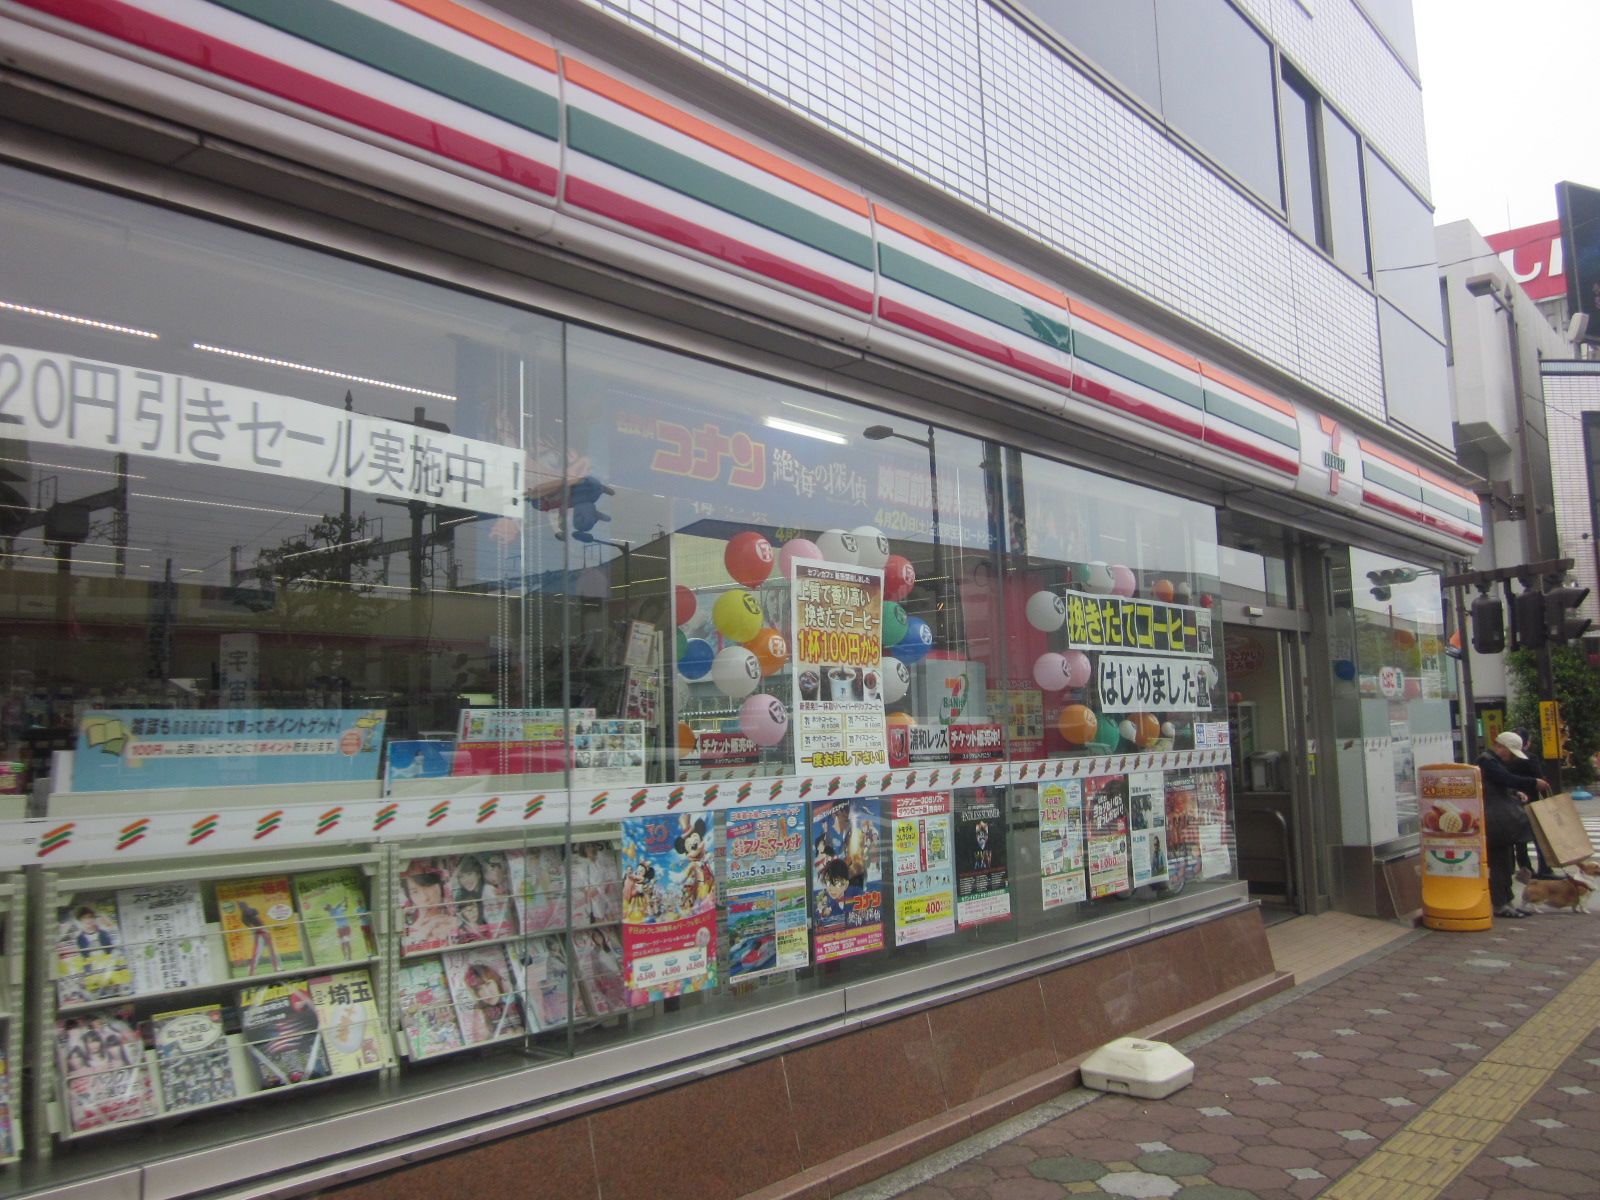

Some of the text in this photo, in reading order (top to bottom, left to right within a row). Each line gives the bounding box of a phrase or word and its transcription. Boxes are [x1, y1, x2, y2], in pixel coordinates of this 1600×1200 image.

[651, 419, 766, 491] コナン
[772, 447, 868, 508] 絶海の探偵
[798, 580, 870, 608] 上質で香り高い
[805, 602, 880, 631] 挽きたてコーヒー
[1069, 594, 1198, 650] 挽きたてコーヒー
[798, 627, 881, 667] 1杯100円から
[1101, 661, 1196, 706] はじめました
[910, 728, 1002, 751] 浦和レッズ チケット販売中!
[853, 891, 882, 911] コナン
[328, 980, 373, 1006] 埼玉
